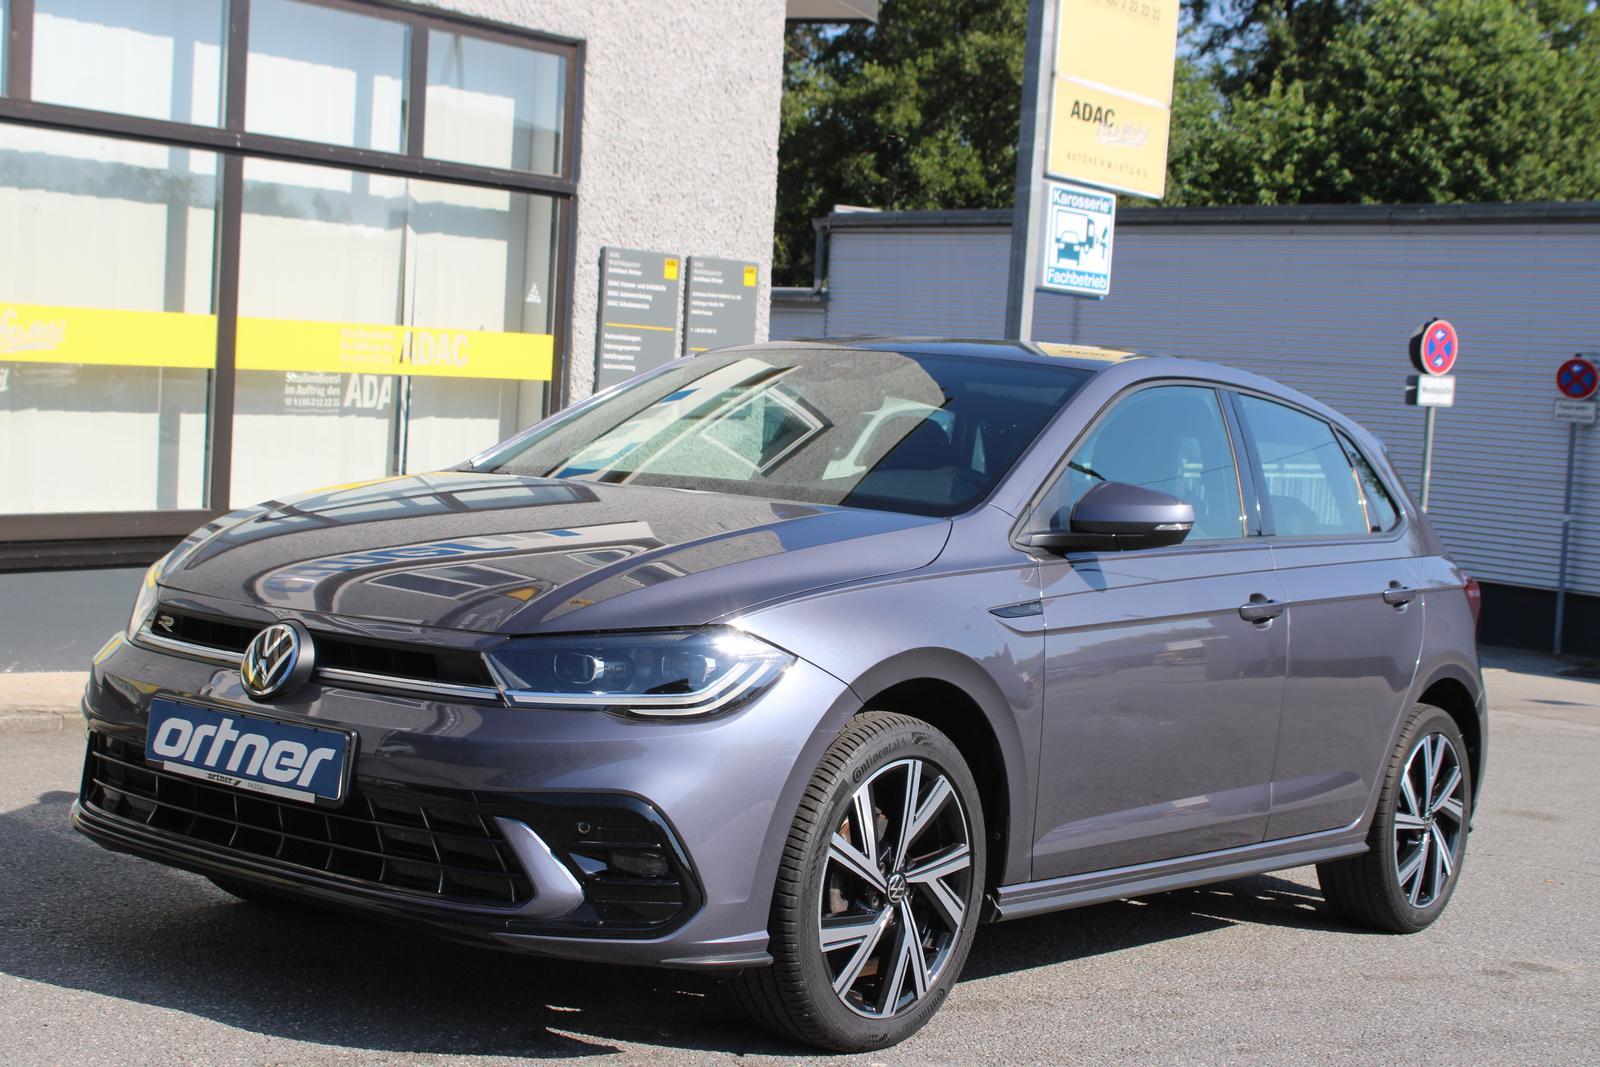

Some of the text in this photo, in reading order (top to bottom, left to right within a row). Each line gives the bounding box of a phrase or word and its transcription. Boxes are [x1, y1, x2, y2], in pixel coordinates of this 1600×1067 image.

[1070, 99, 1116, 128] ADAC
[1053, 189, 1111, 213] Karosserie
[1048, 269, 1107, 289] Fachbetrieb
[401, 330, 469, 368] ADAC
[152, 717, 336, 788] ortner
[851, 737, 900, 784] Continental
[207, 772, 233, 784] ortner
